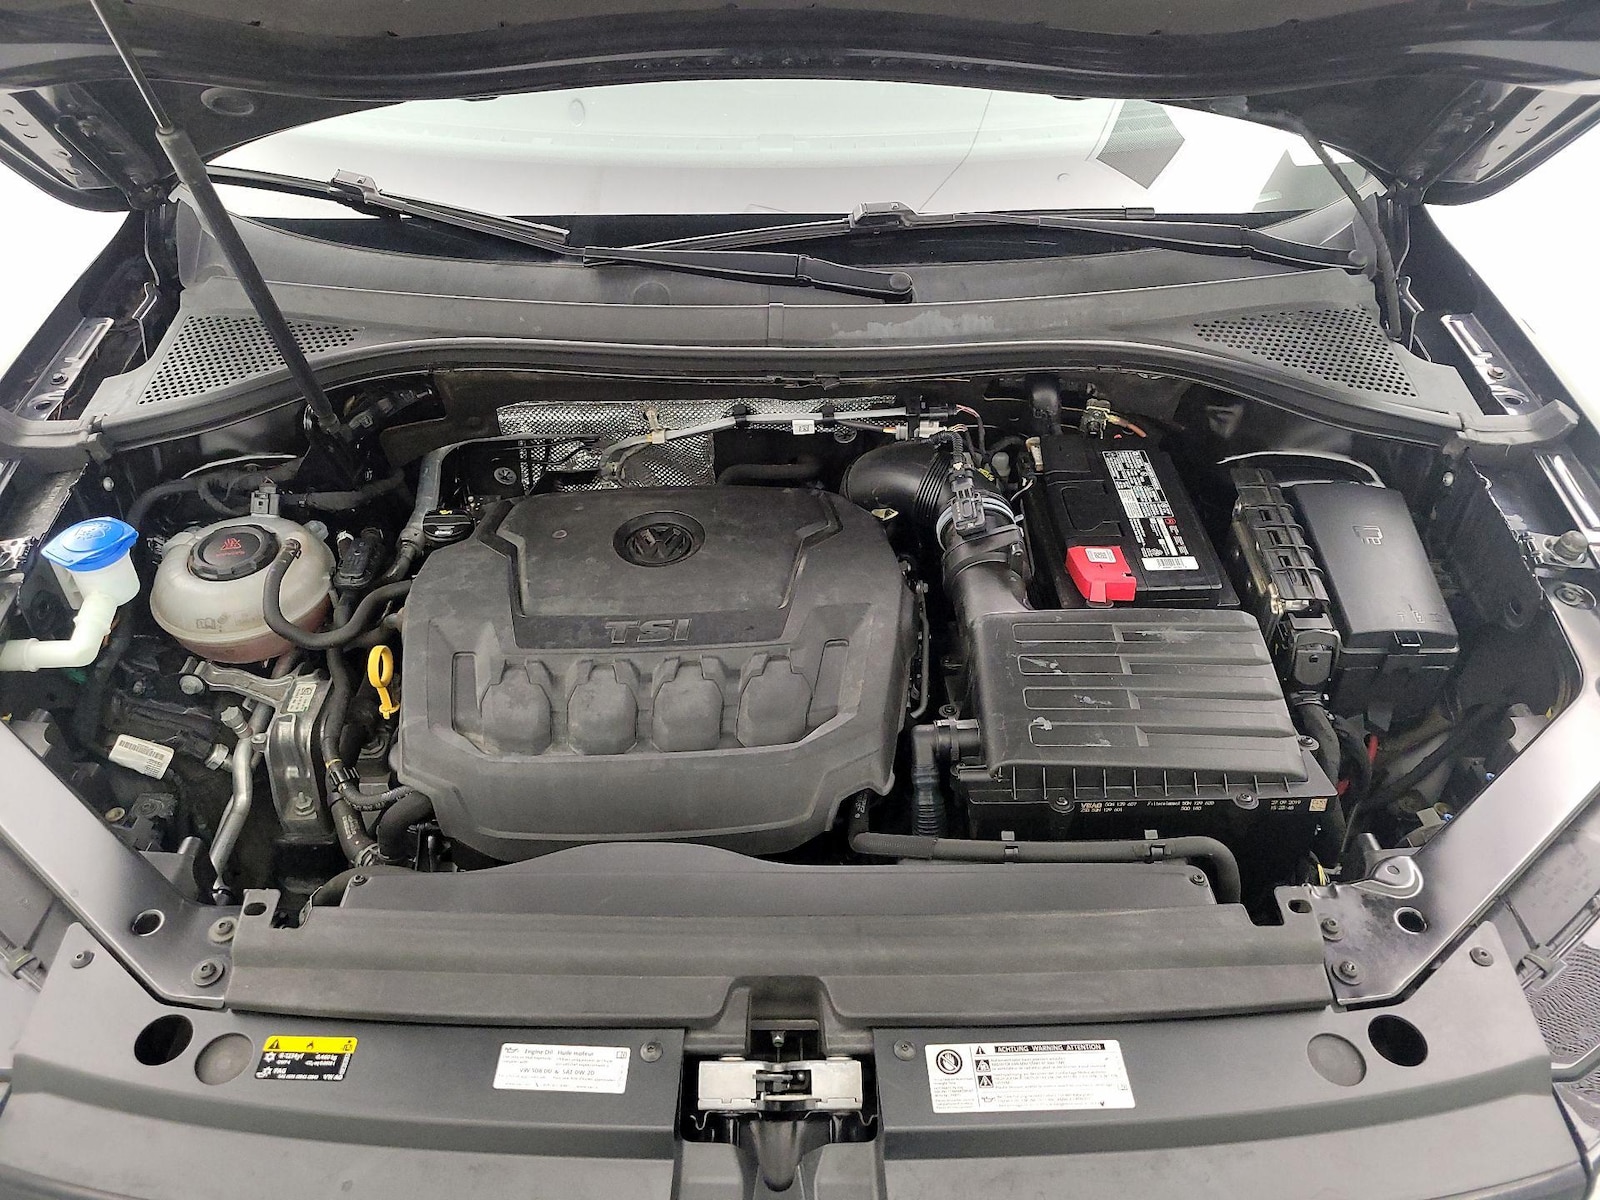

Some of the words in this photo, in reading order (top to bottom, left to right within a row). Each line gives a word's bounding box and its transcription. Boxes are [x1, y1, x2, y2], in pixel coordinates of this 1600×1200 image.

[605, 618, 692, 643] TSI
[997, 1045, 1029, 1053] ACHTUNG
[1031, 1044, 1064, 1052] WARNING
[1066, 1043, 1102, 1051] ATTENTION
